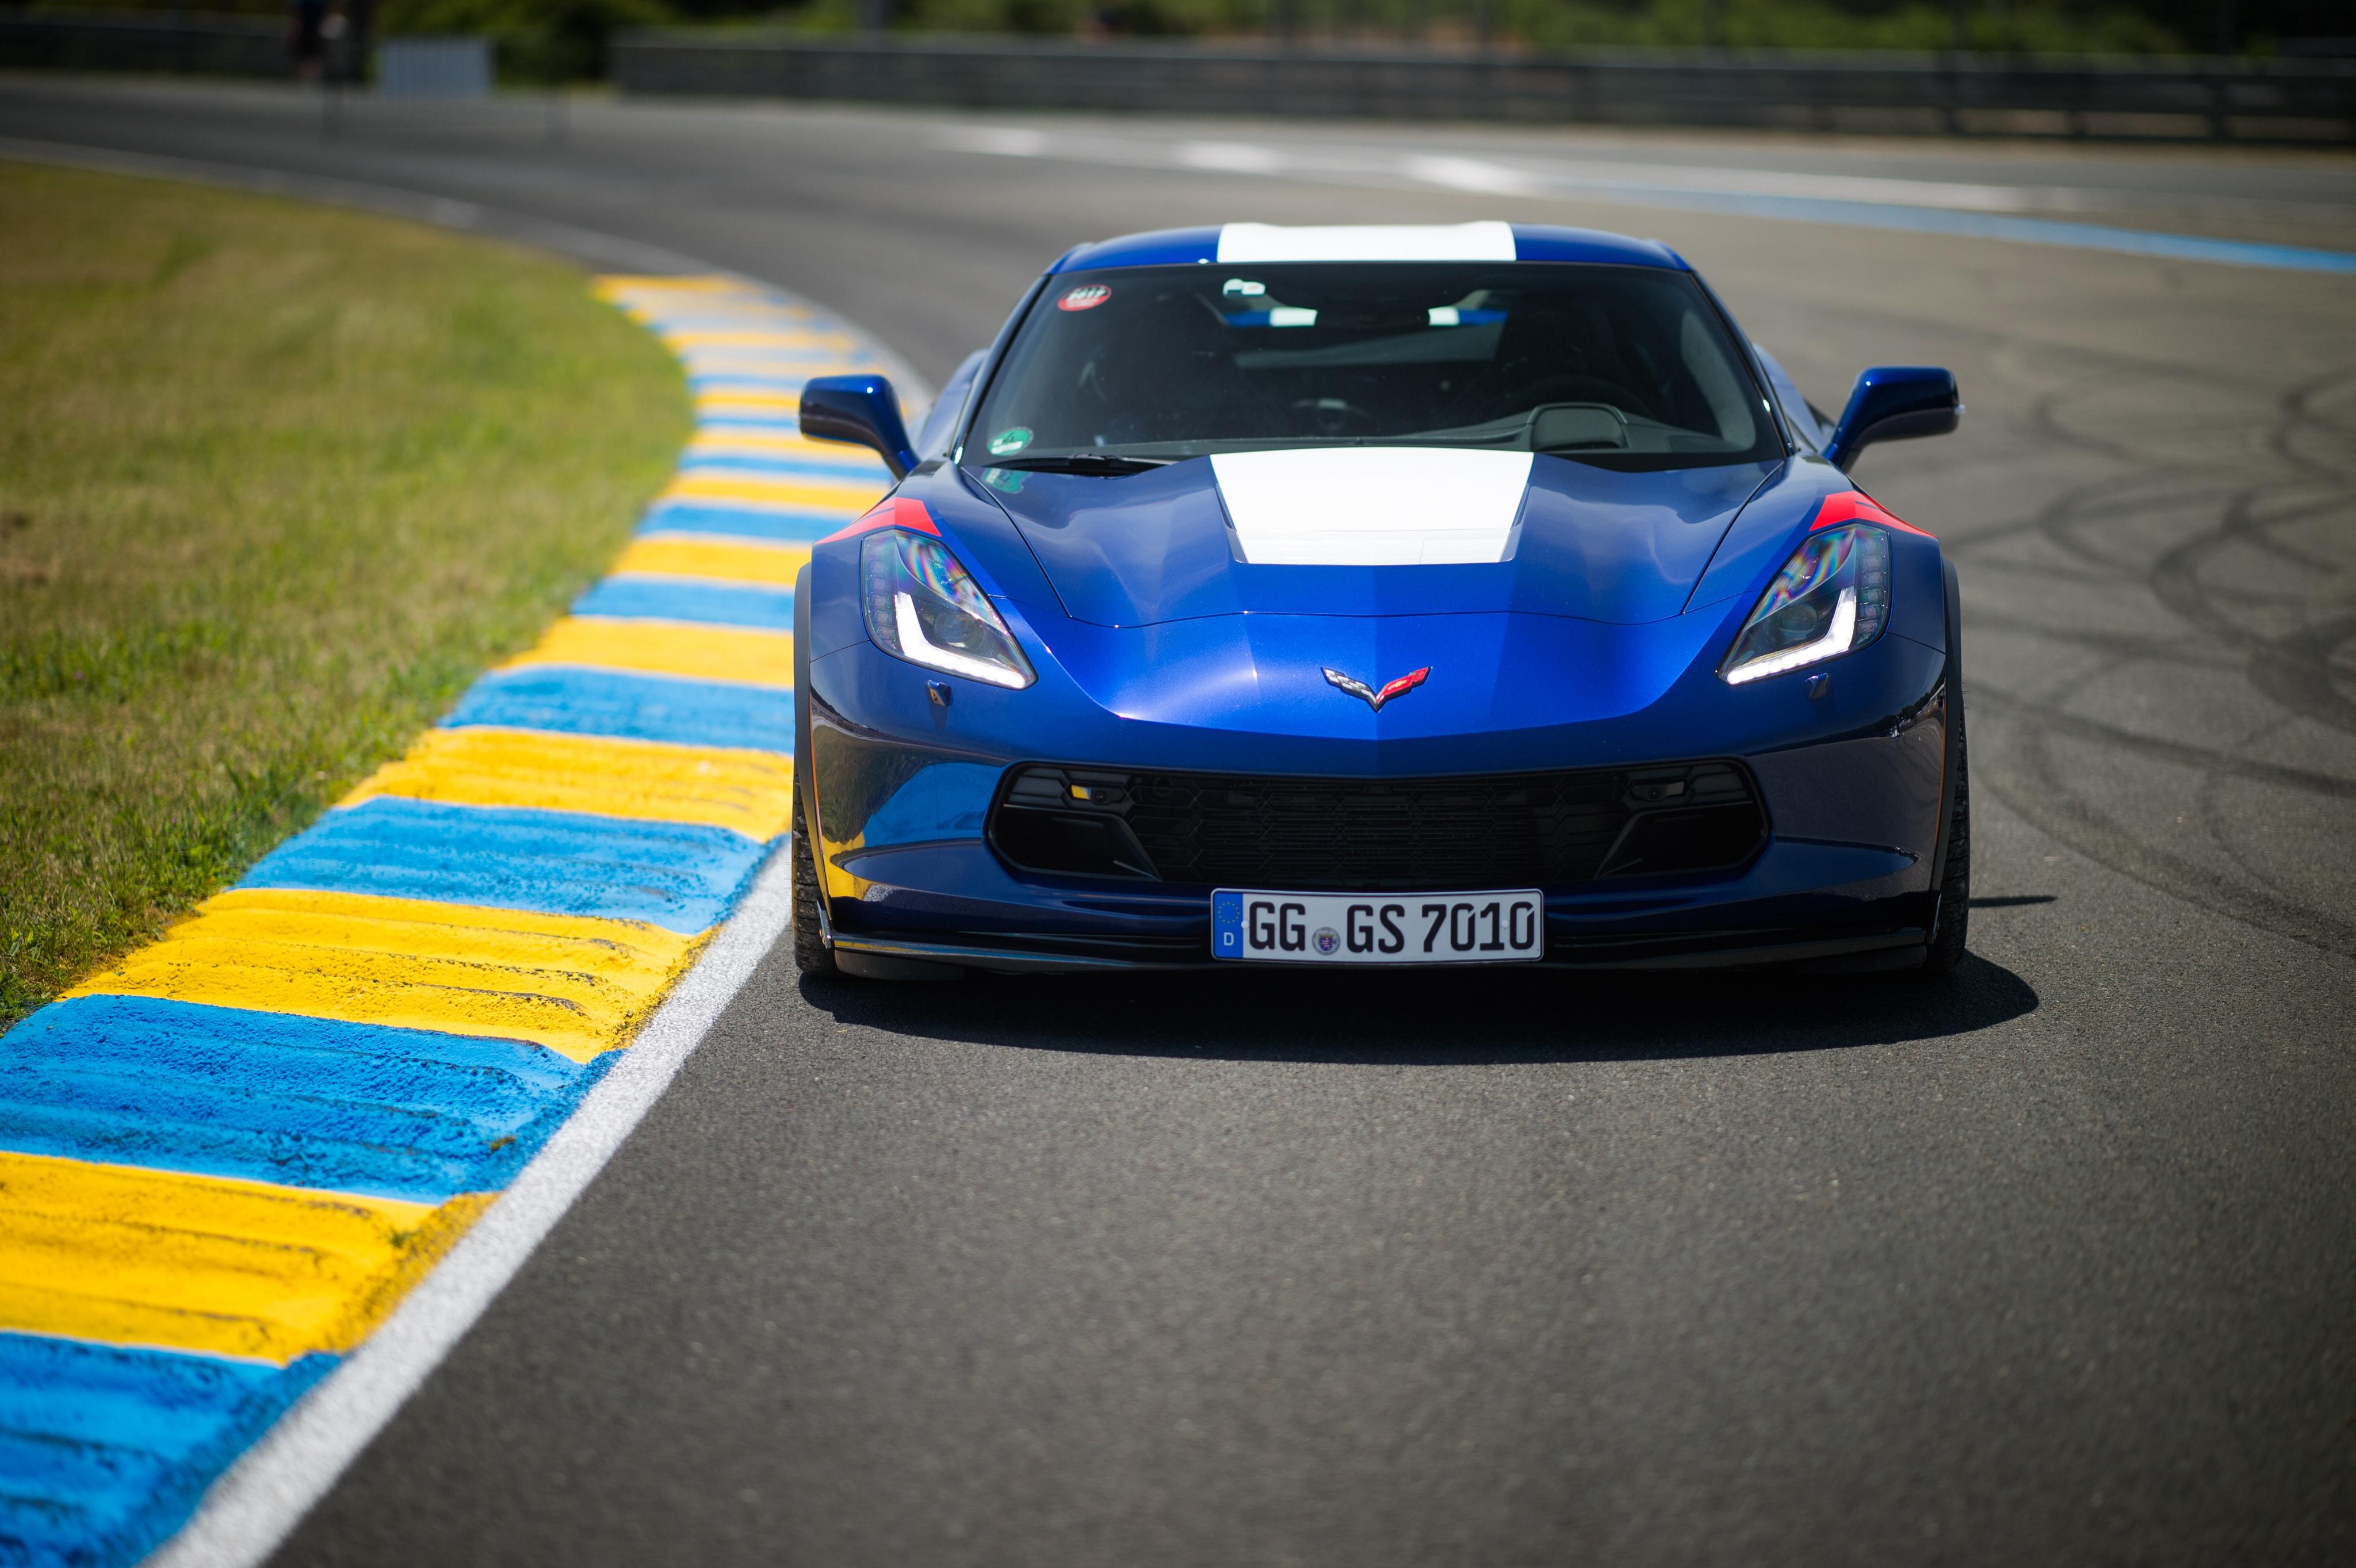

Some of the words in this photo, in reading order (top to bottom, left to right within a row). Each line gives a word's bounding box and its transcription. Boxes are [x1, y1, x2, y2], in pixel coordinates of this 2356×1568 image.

[1223, 931, 1234, 946] D
[1249, 901, 1306, 951] GG
[1347, 904, 1405, 953] GS
[1422, 901, 1535, 953] 7010
